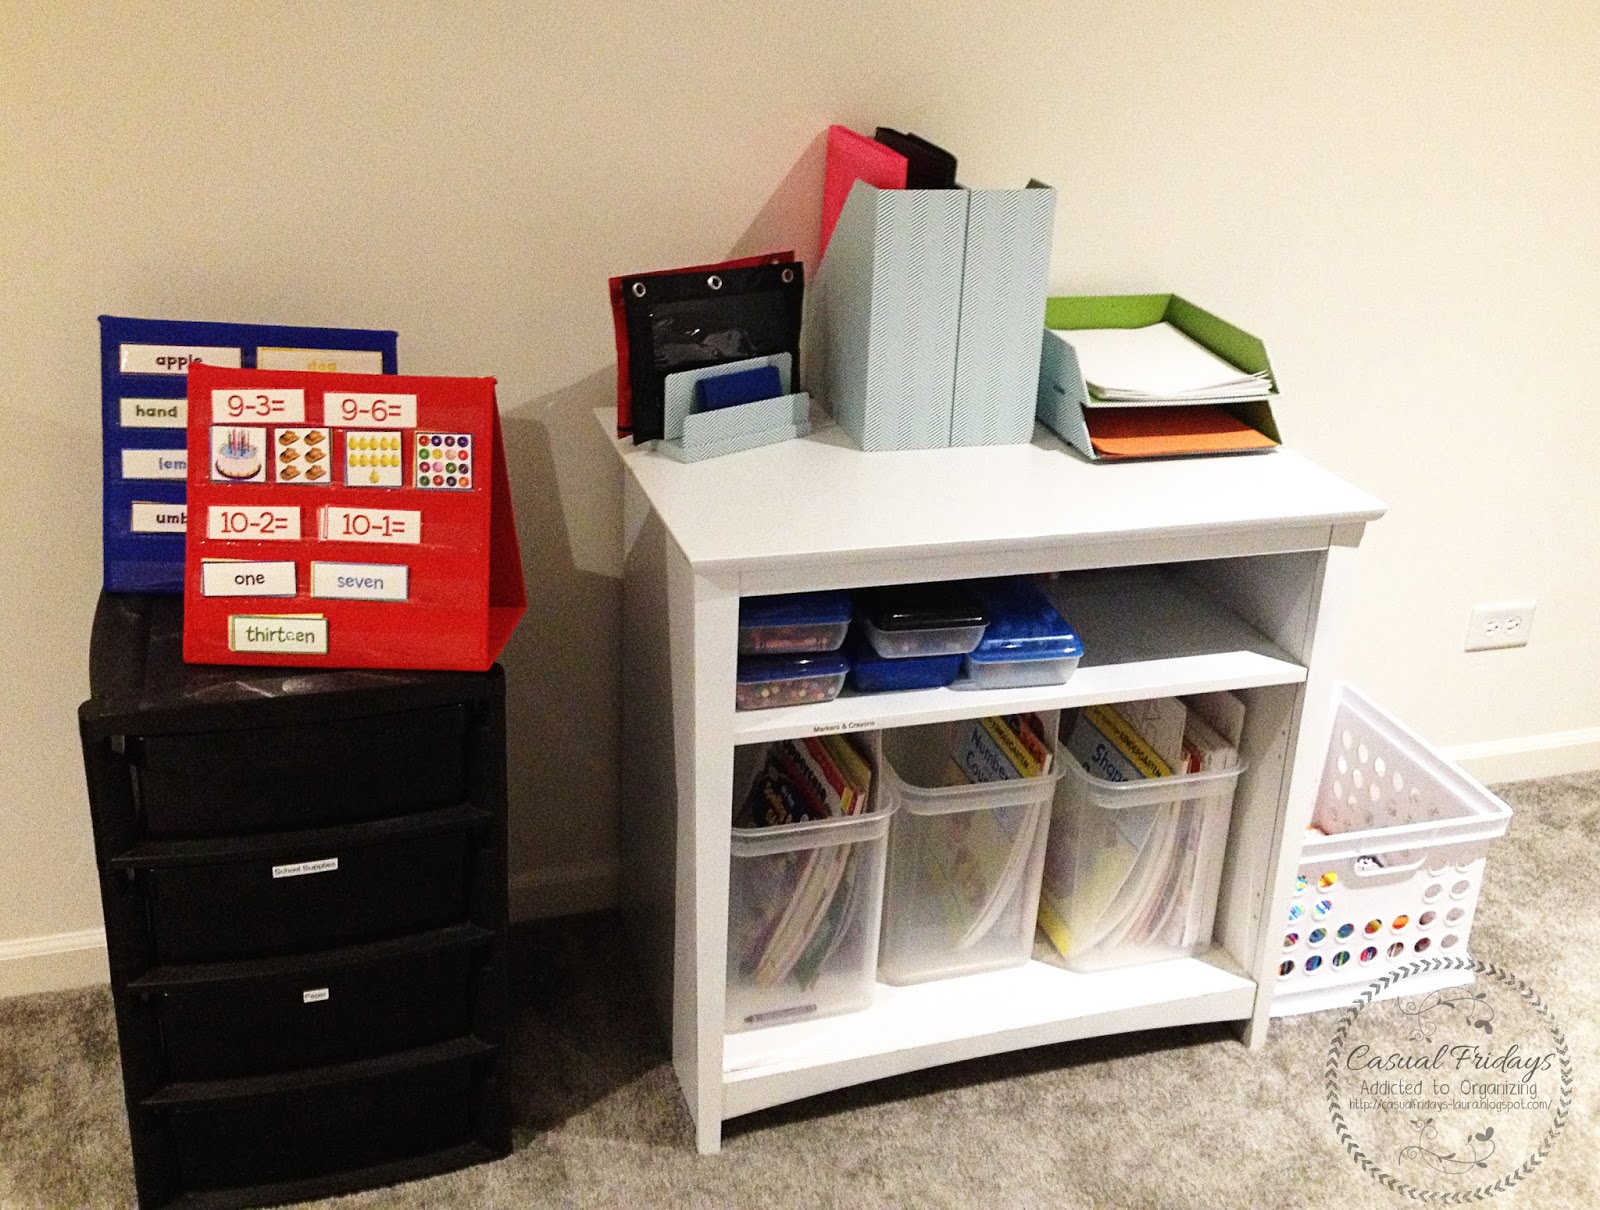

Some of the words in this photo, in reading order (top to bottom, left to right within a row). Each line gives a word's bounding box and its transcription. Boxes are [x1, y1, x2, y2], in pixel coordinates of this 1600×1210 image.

[135, 405, 178, 418] hand
[227, 395, 285, 417] 9-3=
[341, 399, 402, 421] 9-6=
[220, 511, 288, 534] 10-2=
[342, 514, 405, 537] 10-1=
[234, 571, 265, 586] one
[337, 576, 383, 590] seven
[246, 626, 315, 645] thirteen
